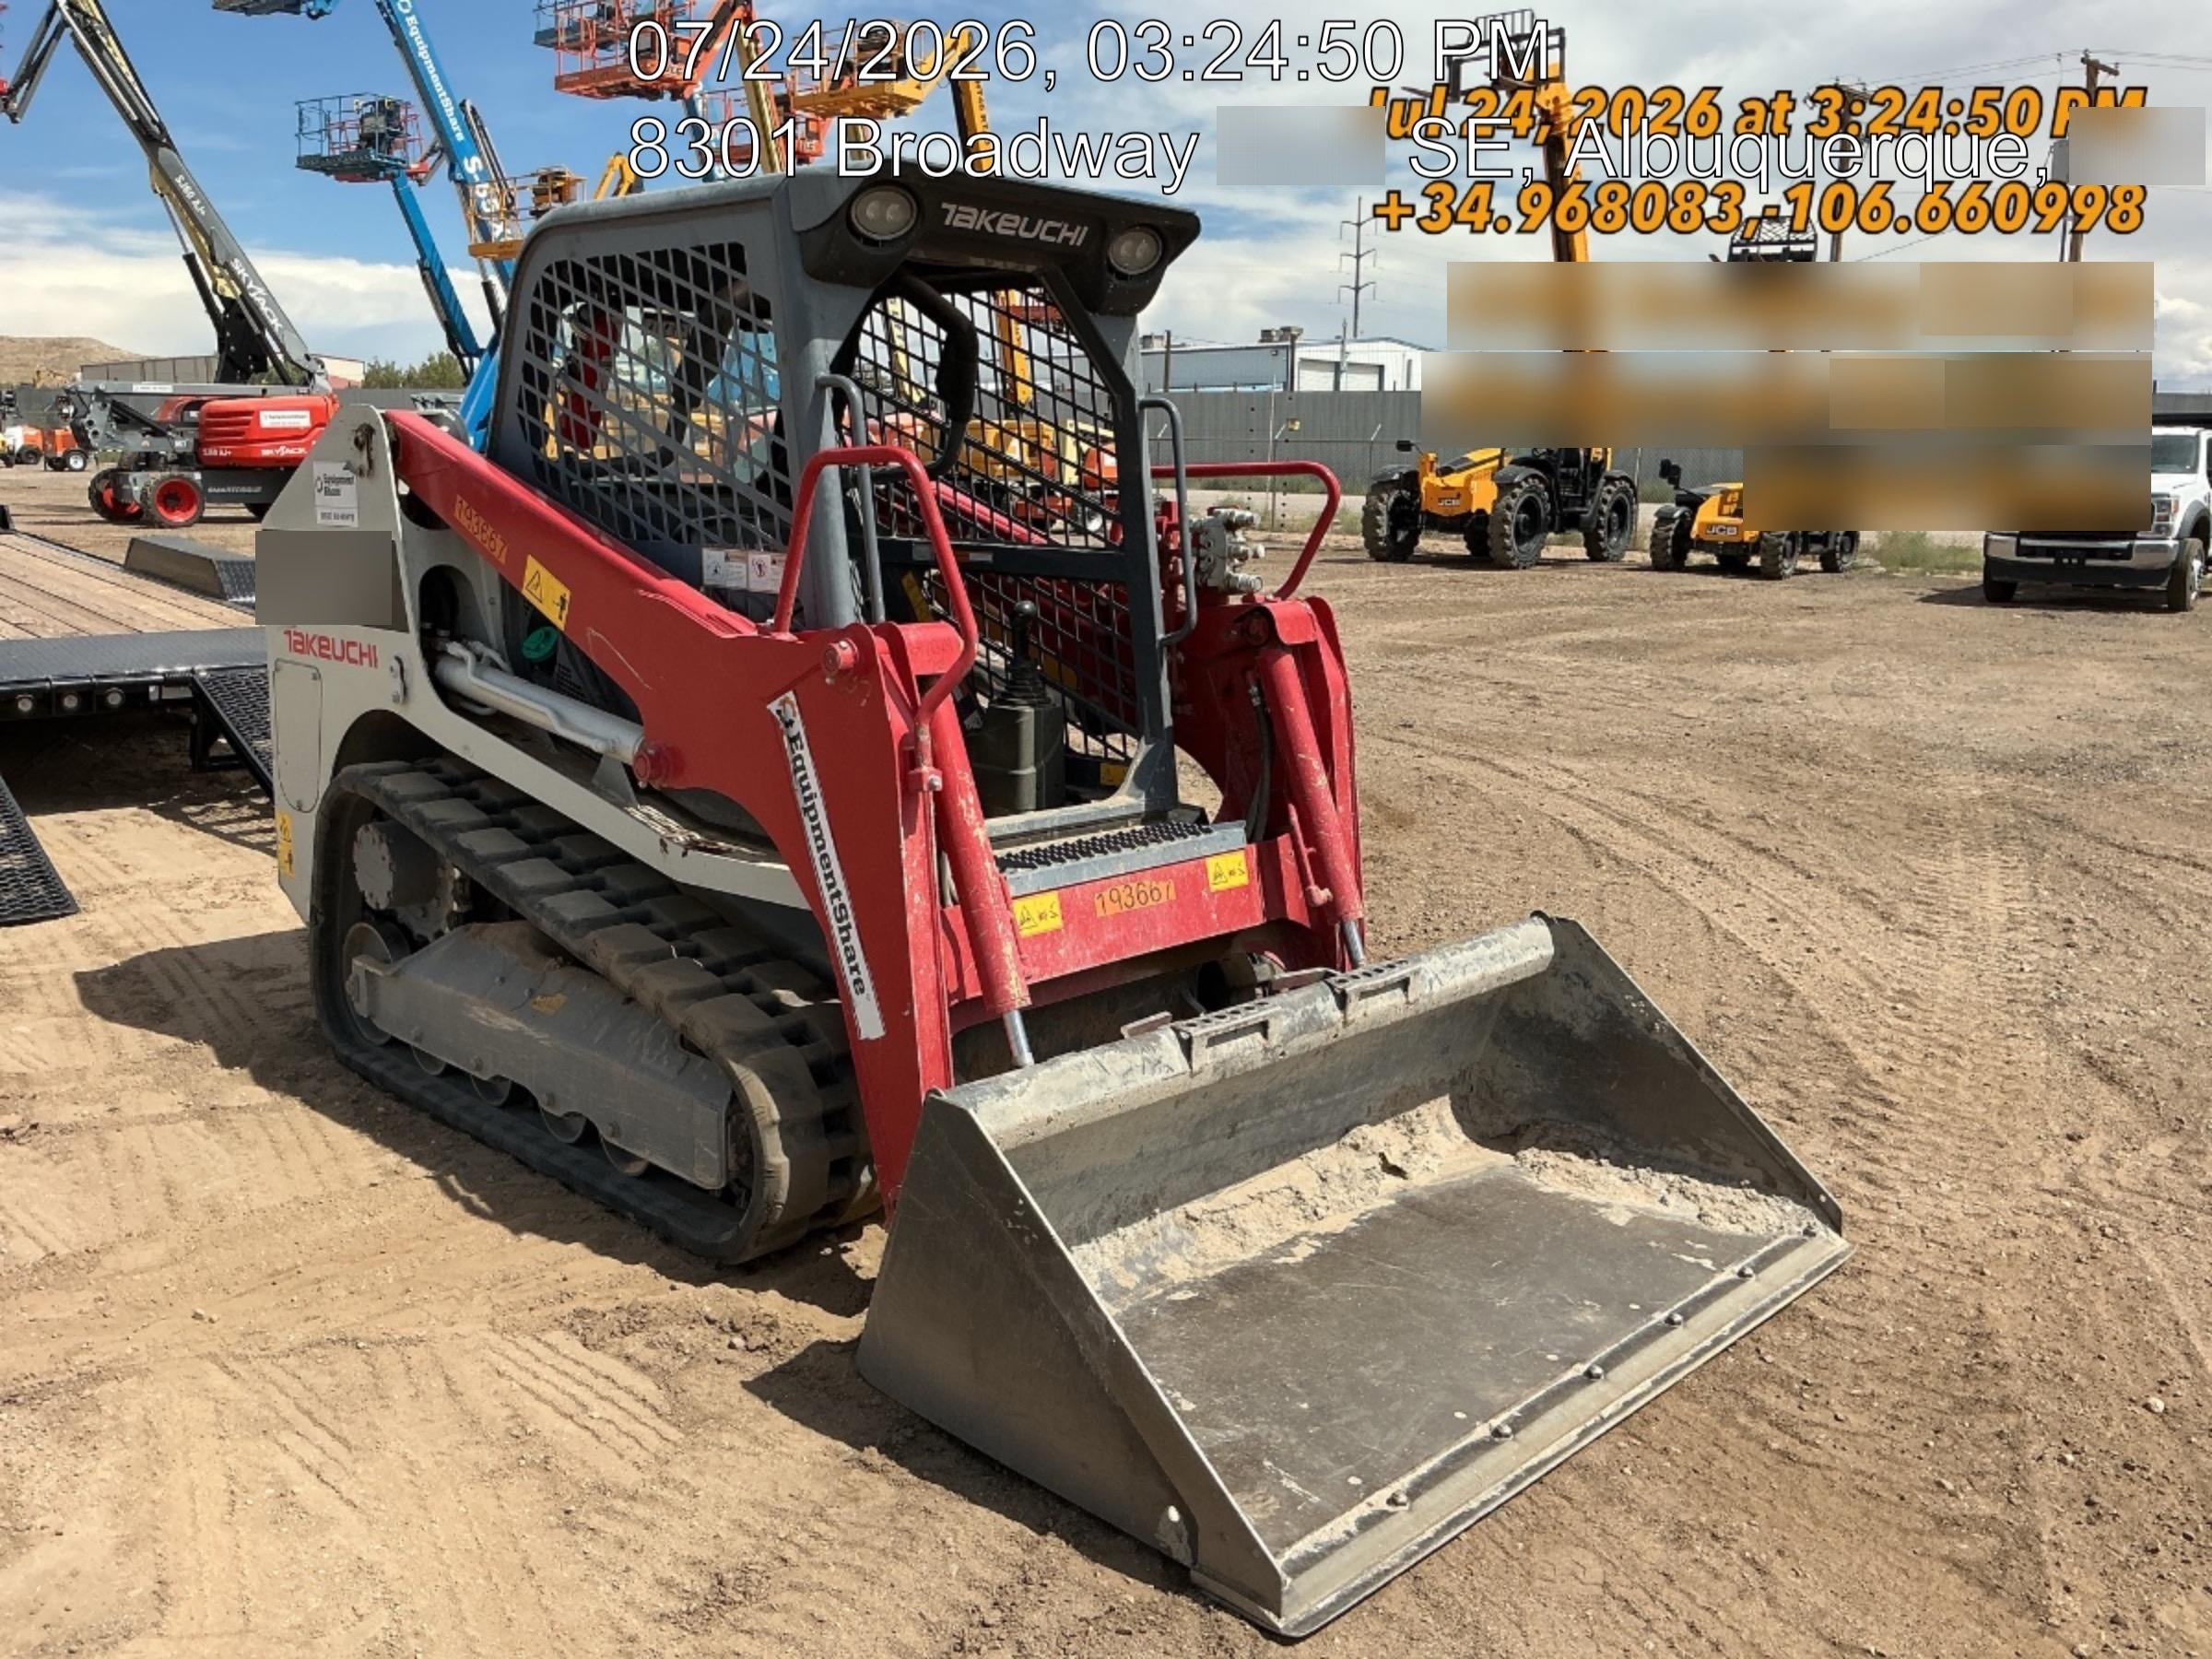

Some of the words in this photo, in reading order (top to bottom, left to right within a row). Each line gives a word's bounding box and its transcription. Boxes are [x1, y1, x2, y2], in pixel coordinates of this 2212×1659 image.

[406, 15, 465, 142] EquipmentShare
[940, 201, 1089, 247] TAKEUCHI
[230, 257, 282, 332] SKYJACK
[1706, 524, 1737, 535] JCB
[283, 629, 379, 669] TAKEUCHI
[787, 735, 865, 995] EquipmentShare
